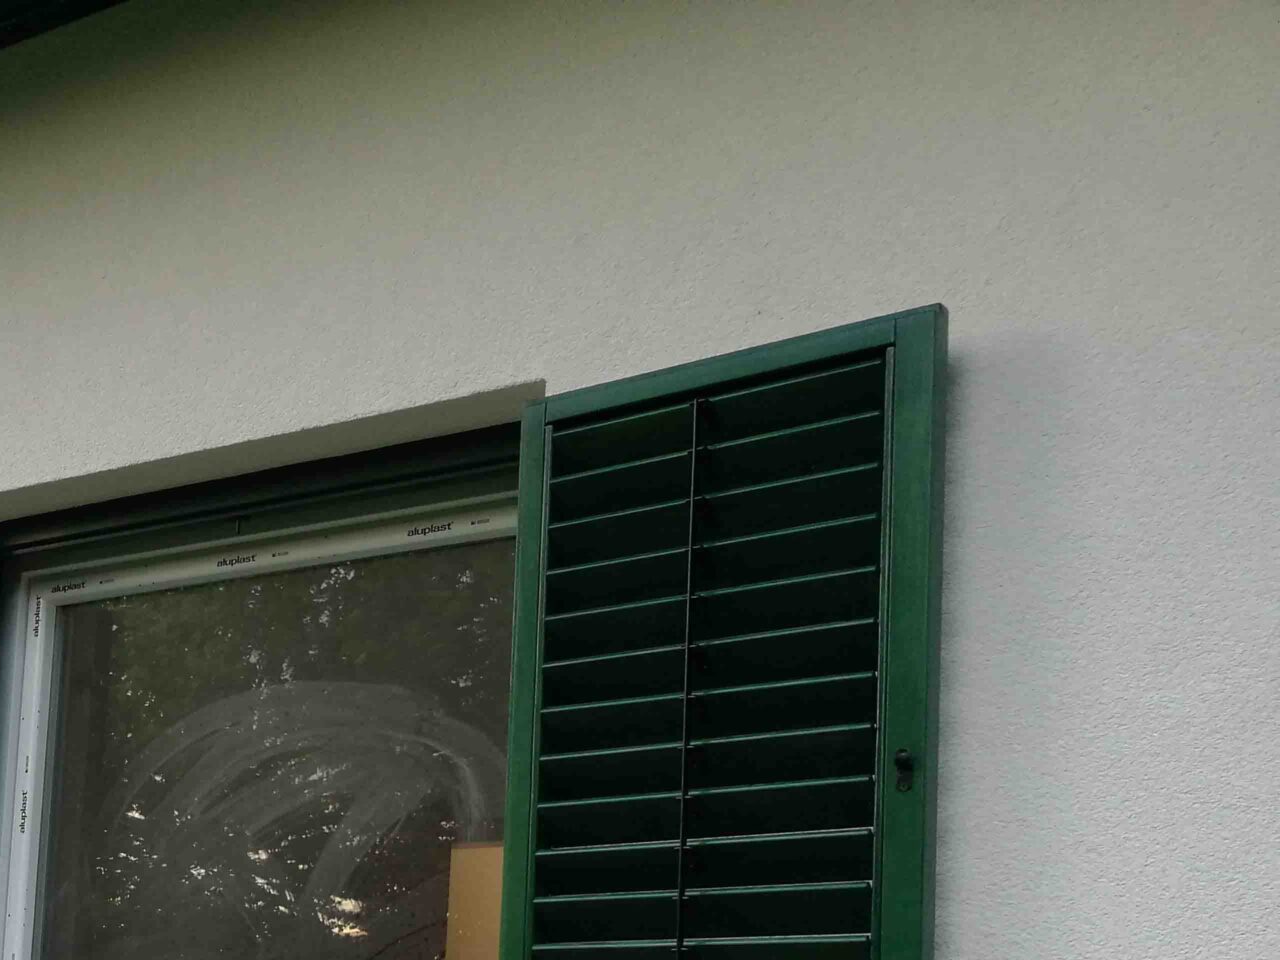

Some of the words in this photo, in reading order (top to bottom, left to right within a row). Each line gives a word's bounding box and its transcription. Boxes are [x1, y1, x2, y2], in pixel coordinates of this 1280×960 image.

[407, 521, 453, 536] aluplast
[217, 554, 256, 567] aluplast
[51, 581, 86, 593] aluplast
[32, 595, 41, 638] aluplast
[19, 790, 28, 833] aluplast
